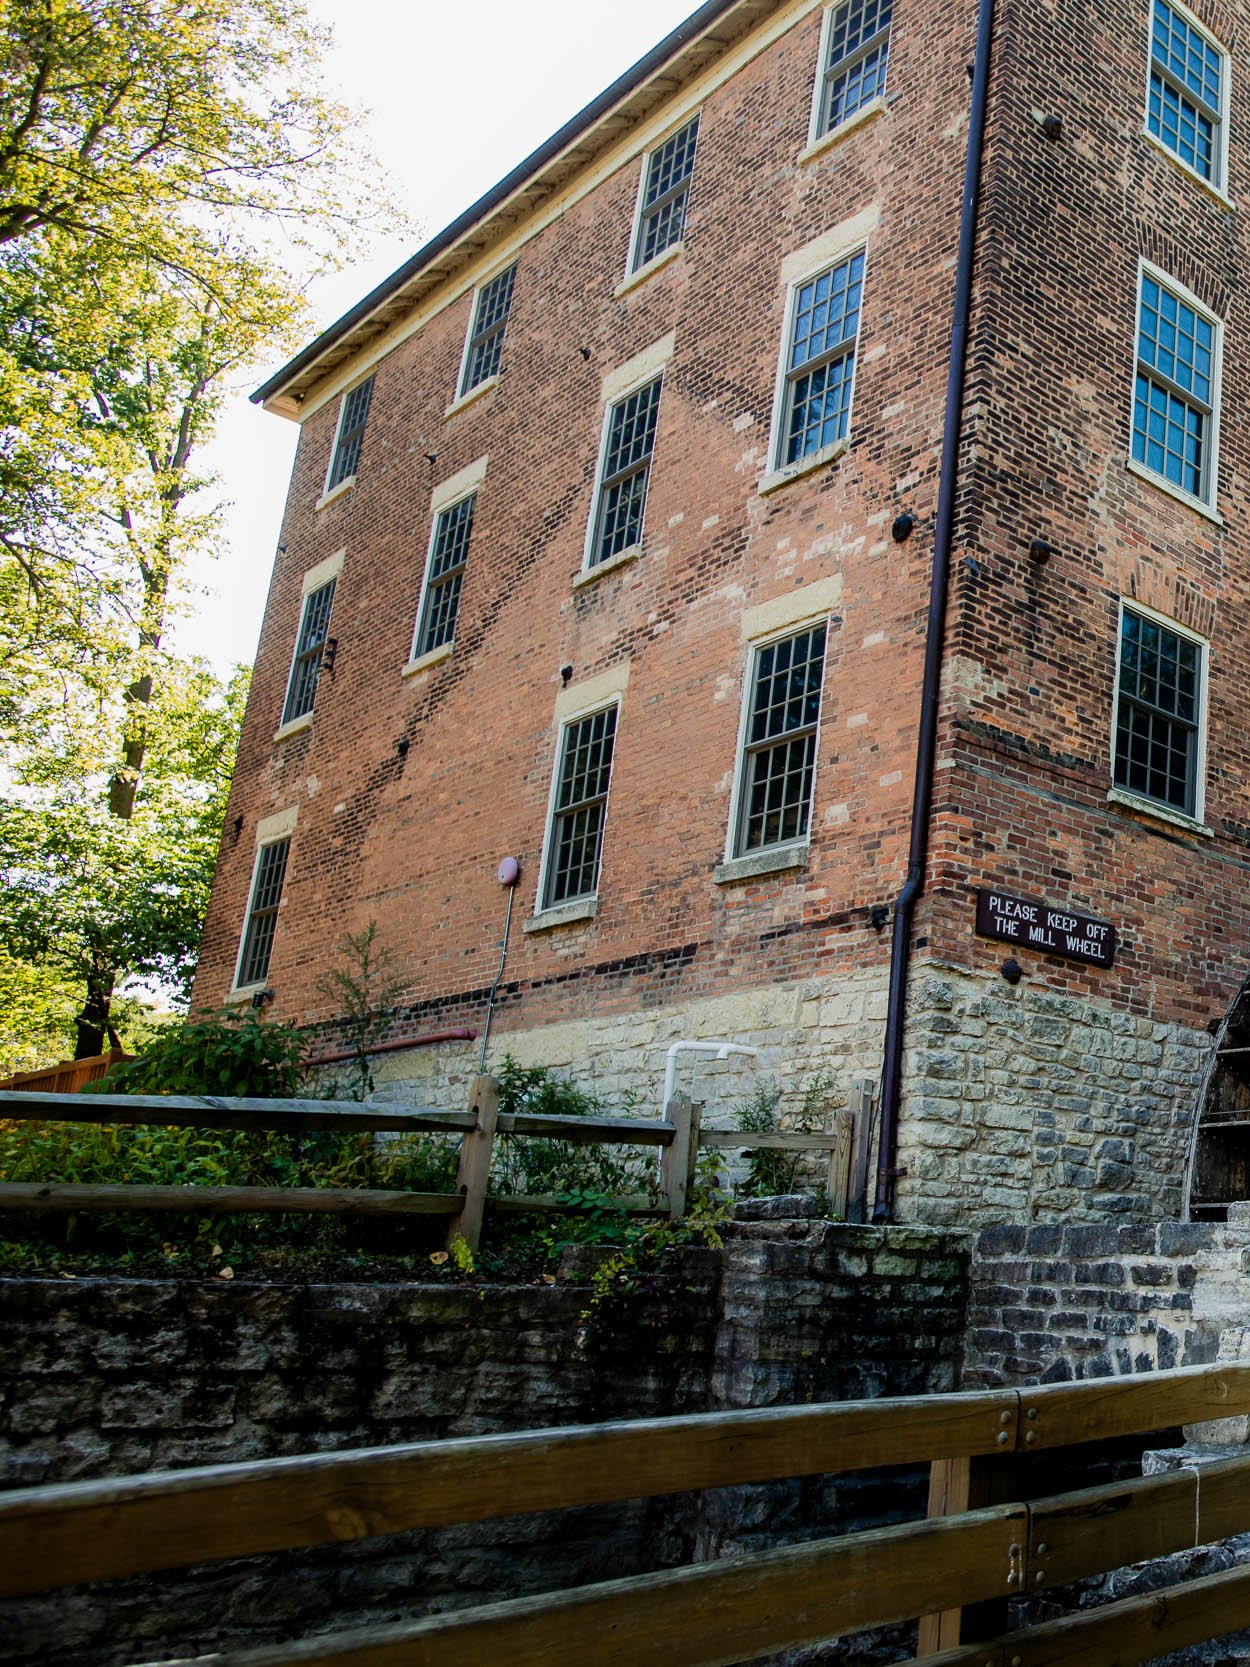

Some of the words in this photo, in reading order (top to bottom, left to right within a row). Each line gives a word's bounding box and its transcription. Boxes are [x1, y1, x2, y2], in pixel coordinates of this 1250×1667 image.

[989, 896, 1038, 922] PLEASE
[1047, 911, 1077, 932] KEEP
[1086, 924, 1108, 940] OFF
[994, 916, 1019, 936] THE
[1029, 925, 1056, 946] MILL
[1066, 935, 1105, 959] WHEEL
